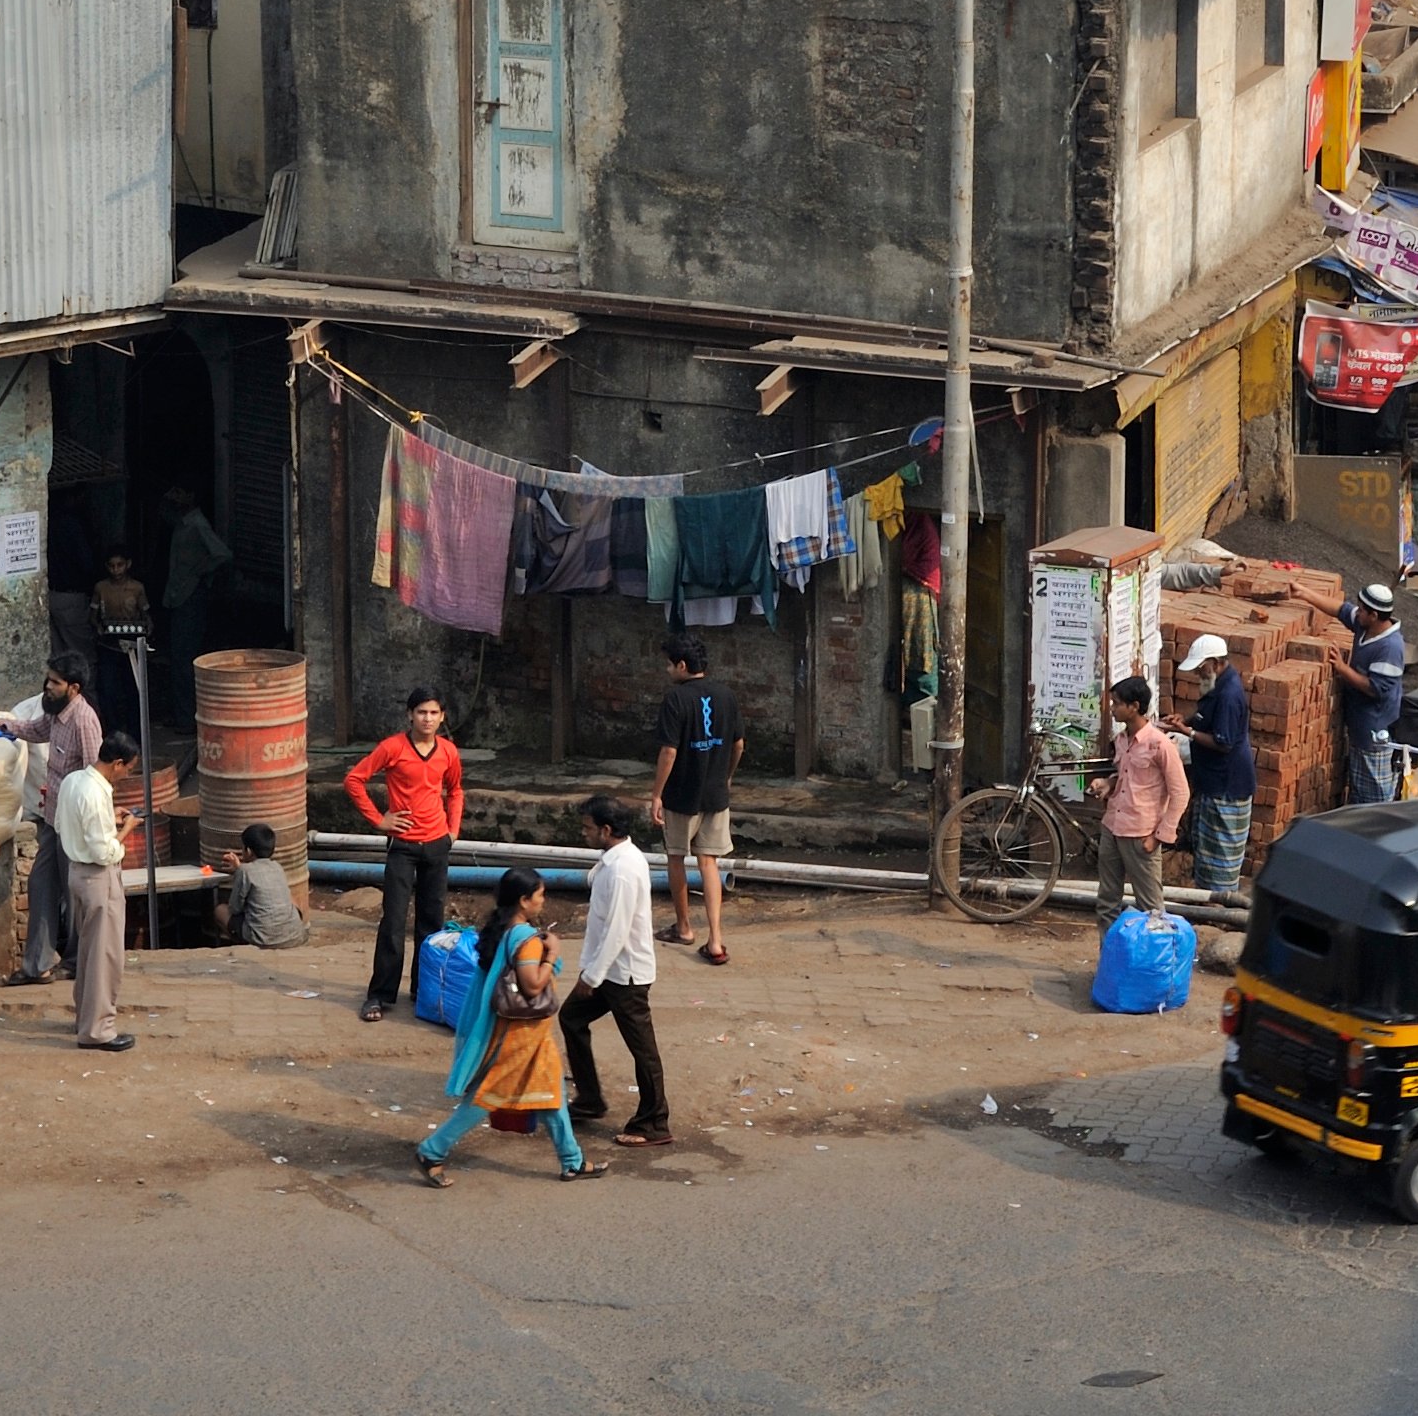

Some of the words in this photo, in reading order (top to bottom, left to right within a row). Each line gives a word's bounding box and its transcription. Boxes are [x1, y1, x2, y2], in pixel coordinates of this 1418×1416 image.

[1329, 202, 1341, 216] 6
[1359, 228, 1389, 245] LOOP
[1347, 348, 1369, 360] MTS
[1338, 471, 1391, 497] STD
[1036, 577, 1047, 597] 2
